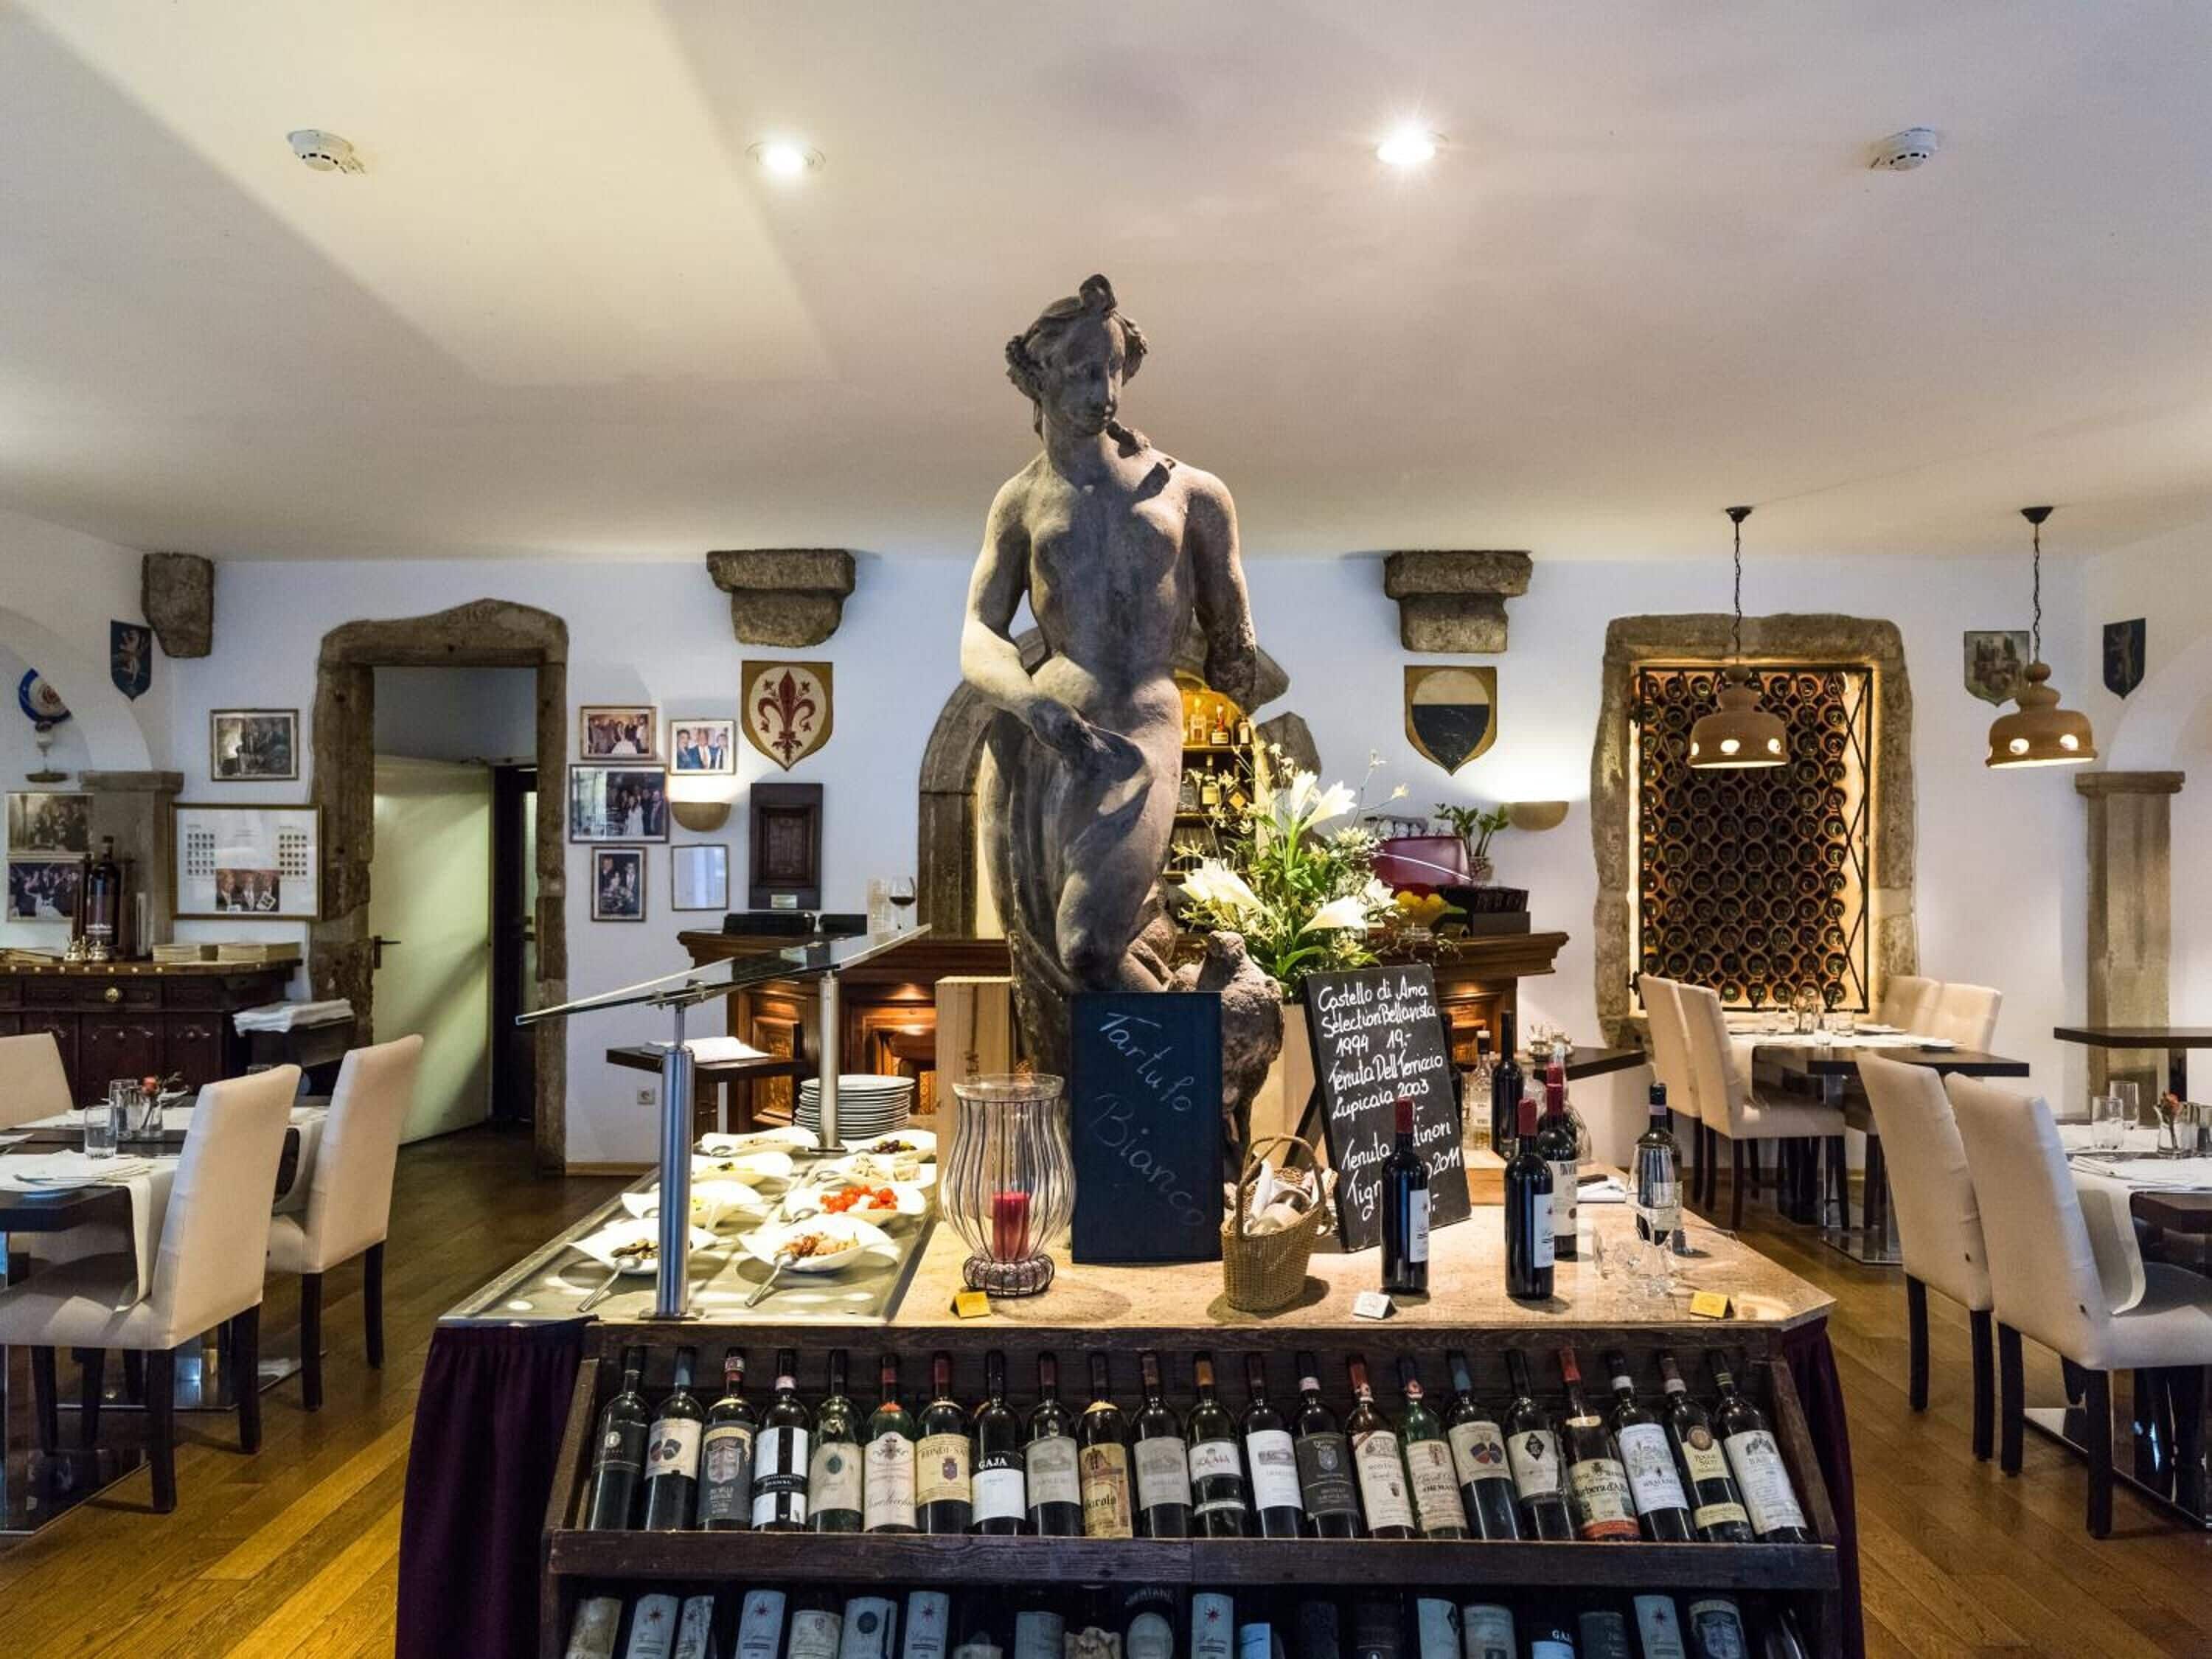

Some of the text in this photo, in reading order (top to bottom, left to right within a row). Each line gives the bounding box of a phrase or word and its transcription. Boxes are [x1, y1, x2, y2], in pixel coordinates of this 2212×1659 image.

[1318, 975, 1428, 1013] Castello di Ama
[1321, 1000, 1437, 1038] Selection Bellavista
[1099, 1012, 1194, 1111] Tartufo
[1336, 1035, 1369, 1057] 1994
[1328, 1056, 1374, 1092] Tenuta
[1332, 1089, 1394, 1121] Lupicaia
[1397, 1078, 1430, 1098] 2003
[1089, 1093, 1206, 1227] Bianco
[1341, 1115, 1451, 1171] Tenuta tinori
[1433, 1146, 1461, 1176] 2011
[978, 1457, 1009, 1470] GAJA
